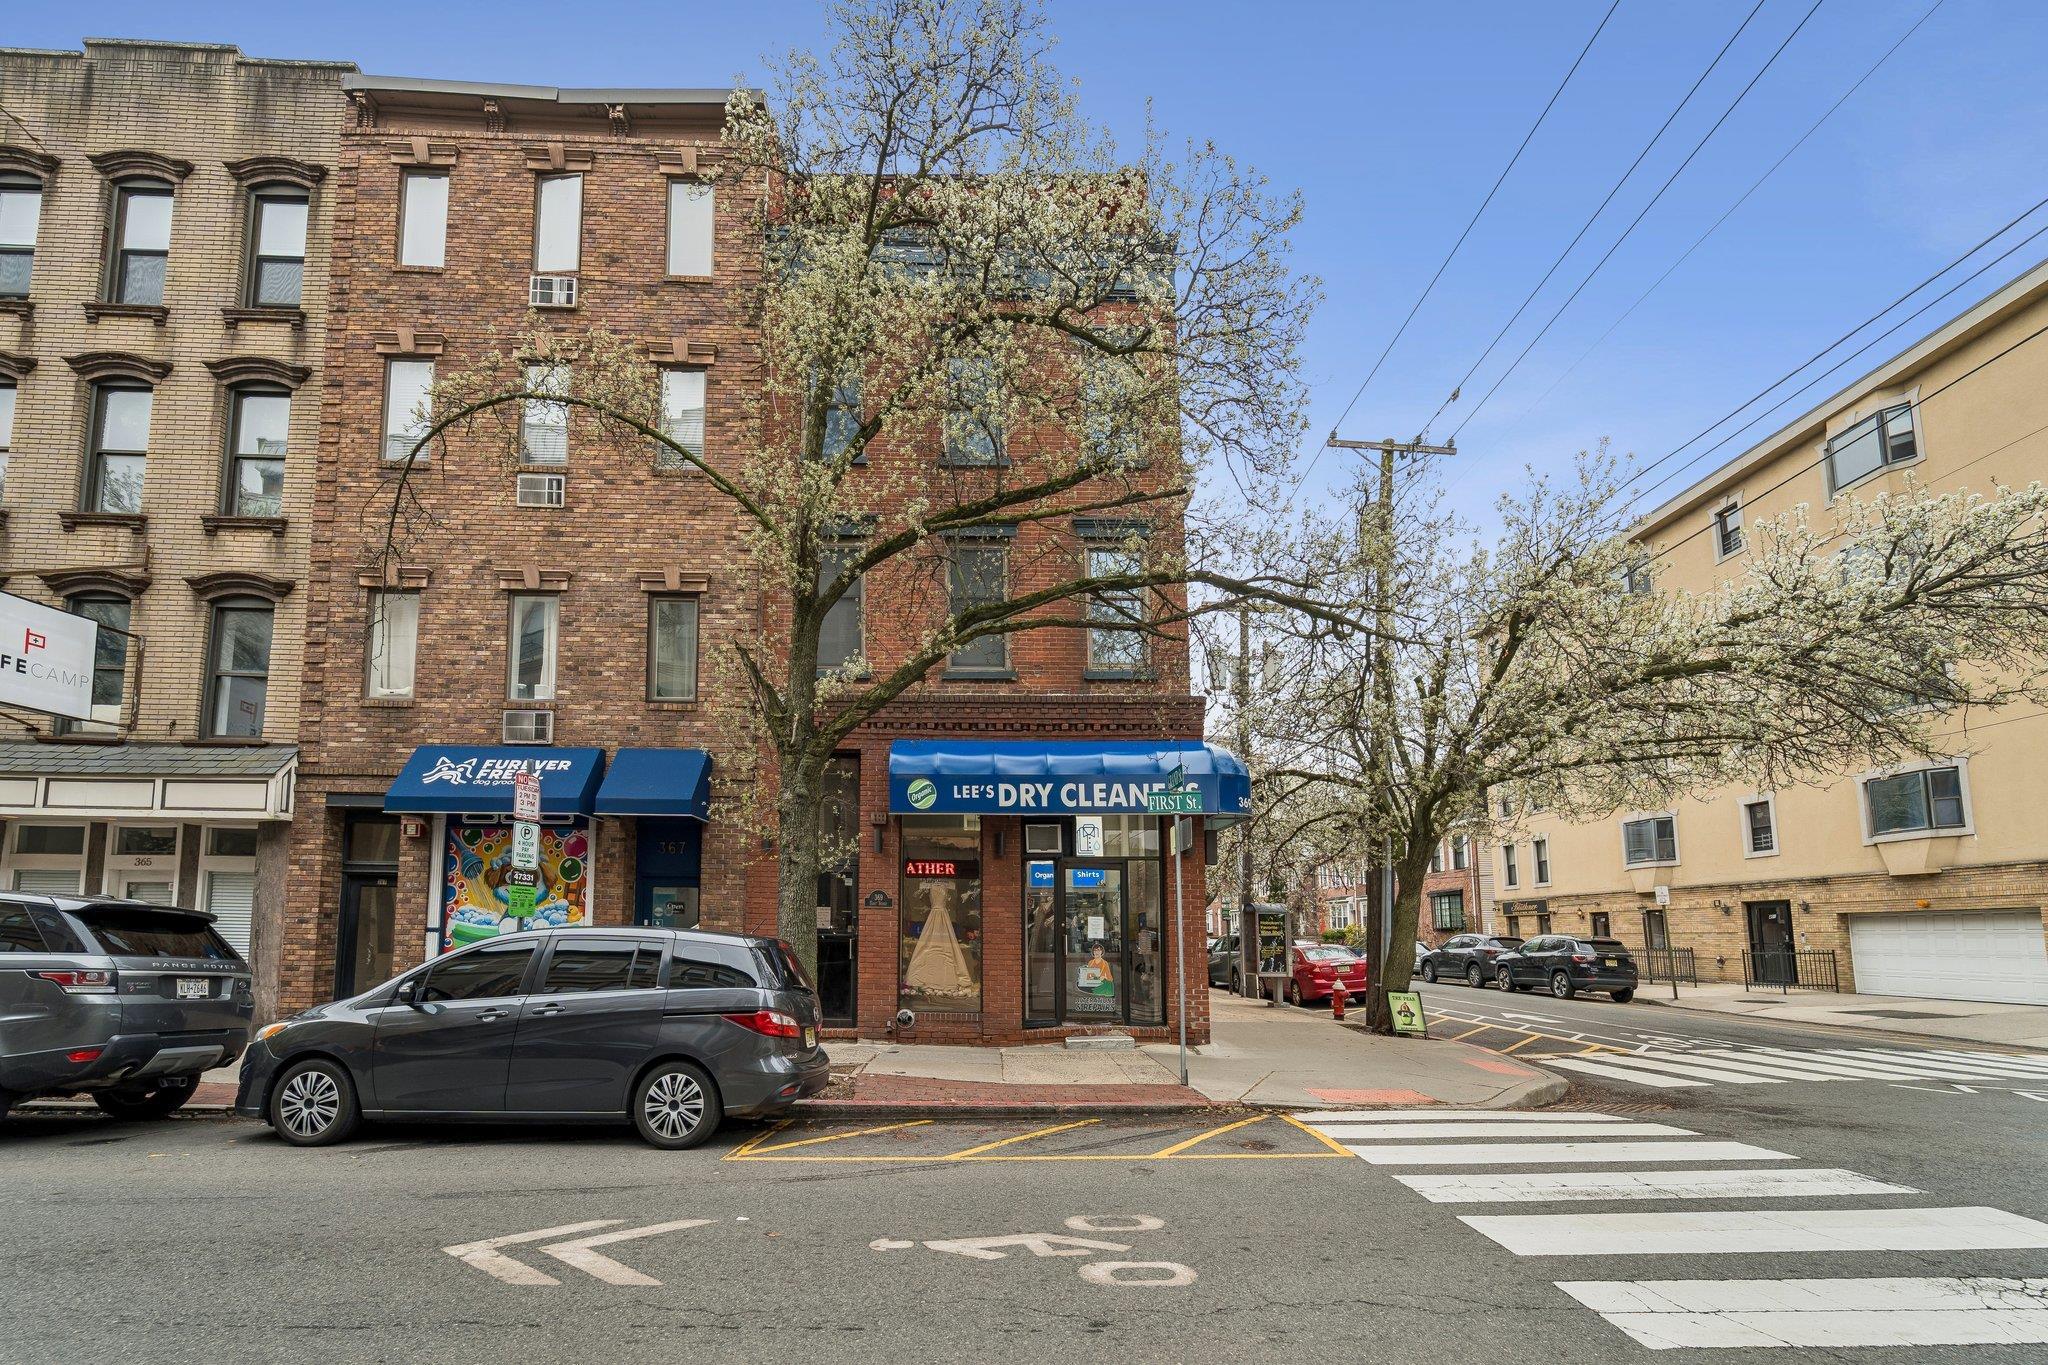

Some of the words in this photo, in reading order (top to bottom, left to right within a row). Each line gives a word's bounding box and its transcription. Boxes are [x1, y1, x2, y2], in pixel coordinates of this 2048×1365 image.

[518, 774, 528, 784] NO
[911, 785, 933, 801] Organic
[953, 785, 995, 798] LEE'S
[998, 783, 1053, 807] DRY
[1149, 795, 1183, 811] FIRST
[1186, 795, 1202, 810] St.
[659, 841, 686, 854] 367
[516, 852, 535, 860] PARKING
[134, 857, 152, 867] 365
[906, 862, 955, 875] ATHER
[513, 872, 534, 881] 47331
[1034, 871, 1054, 880] Organ
